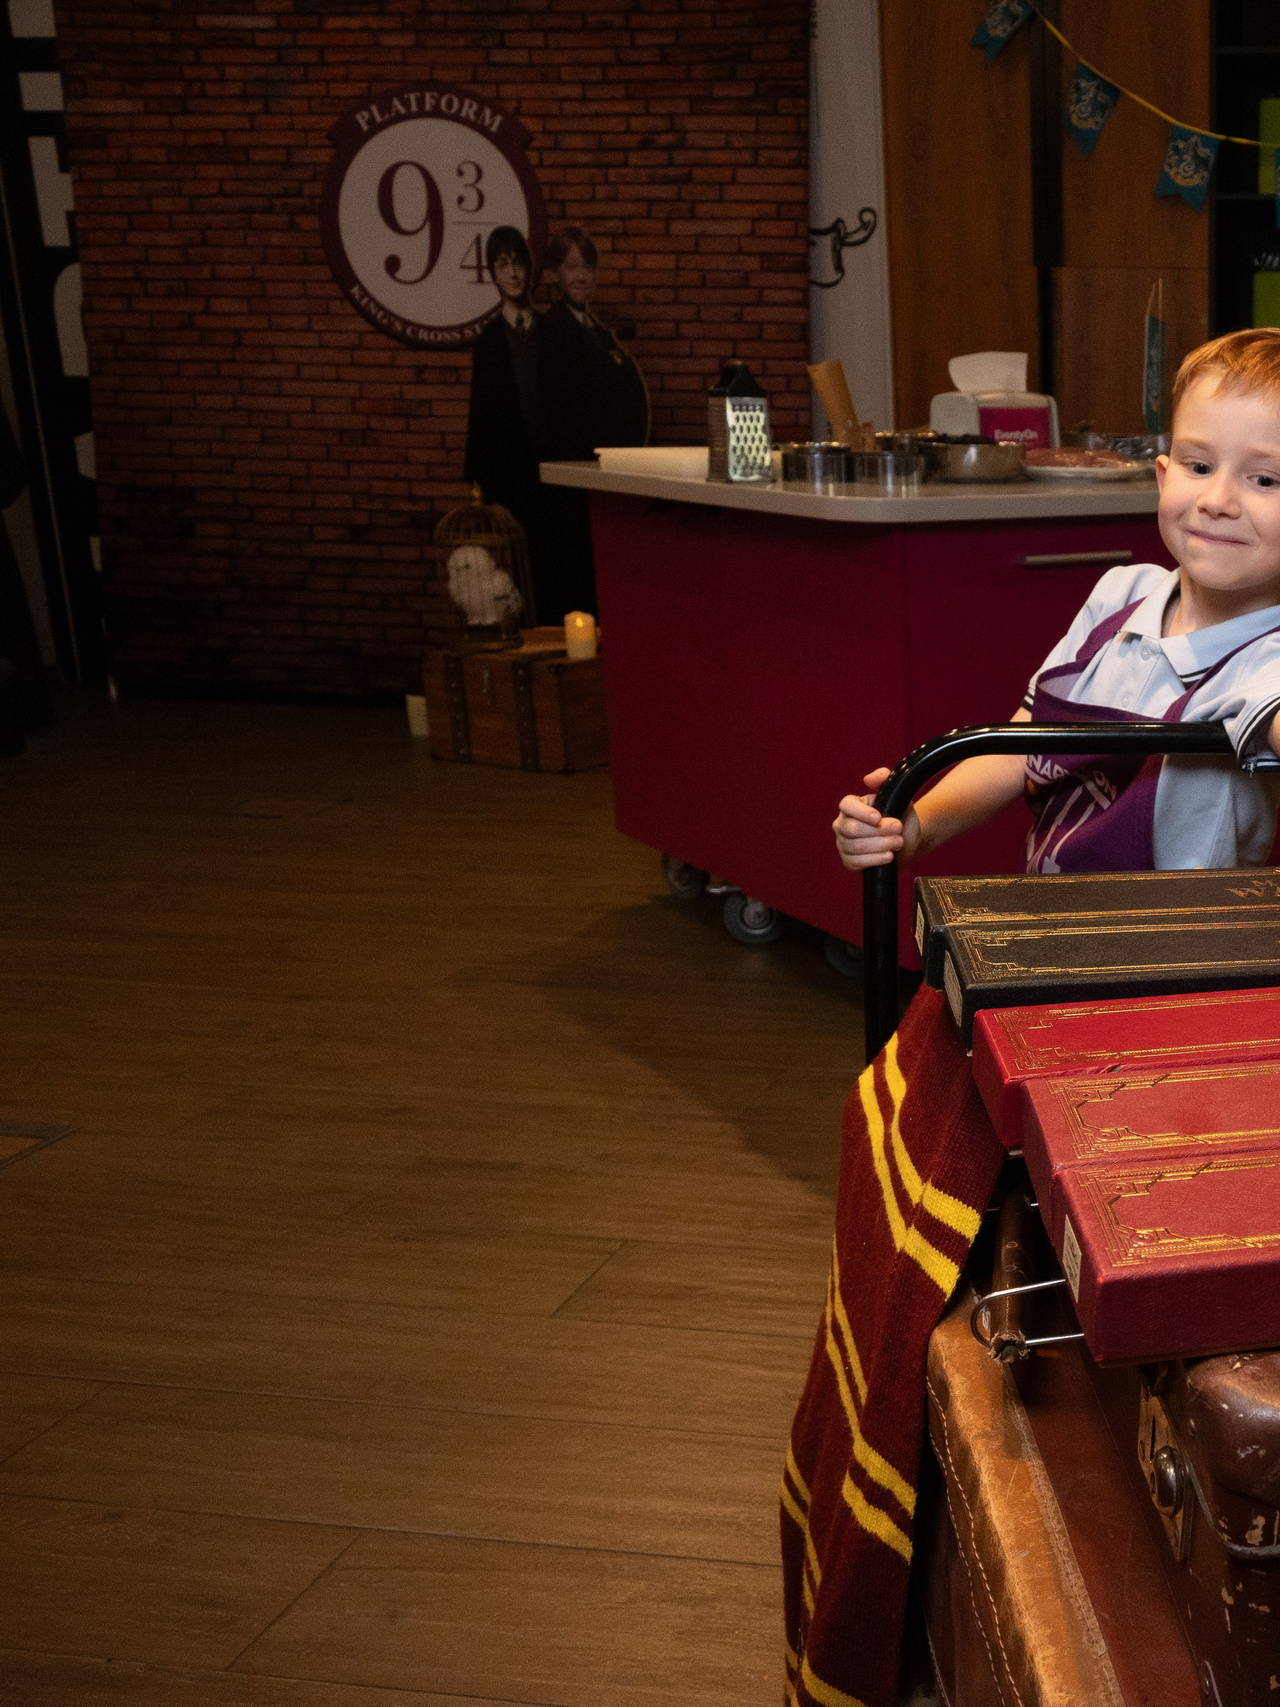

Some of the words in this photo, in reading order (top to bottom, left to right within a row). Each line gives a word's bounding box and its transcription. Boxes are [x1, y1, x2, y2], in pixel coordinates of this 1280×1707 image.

[355, 91, 504, 133] PLATFORM
[377, 160, 445, 285] 9
[406, 324, 462, 344] CROSS
